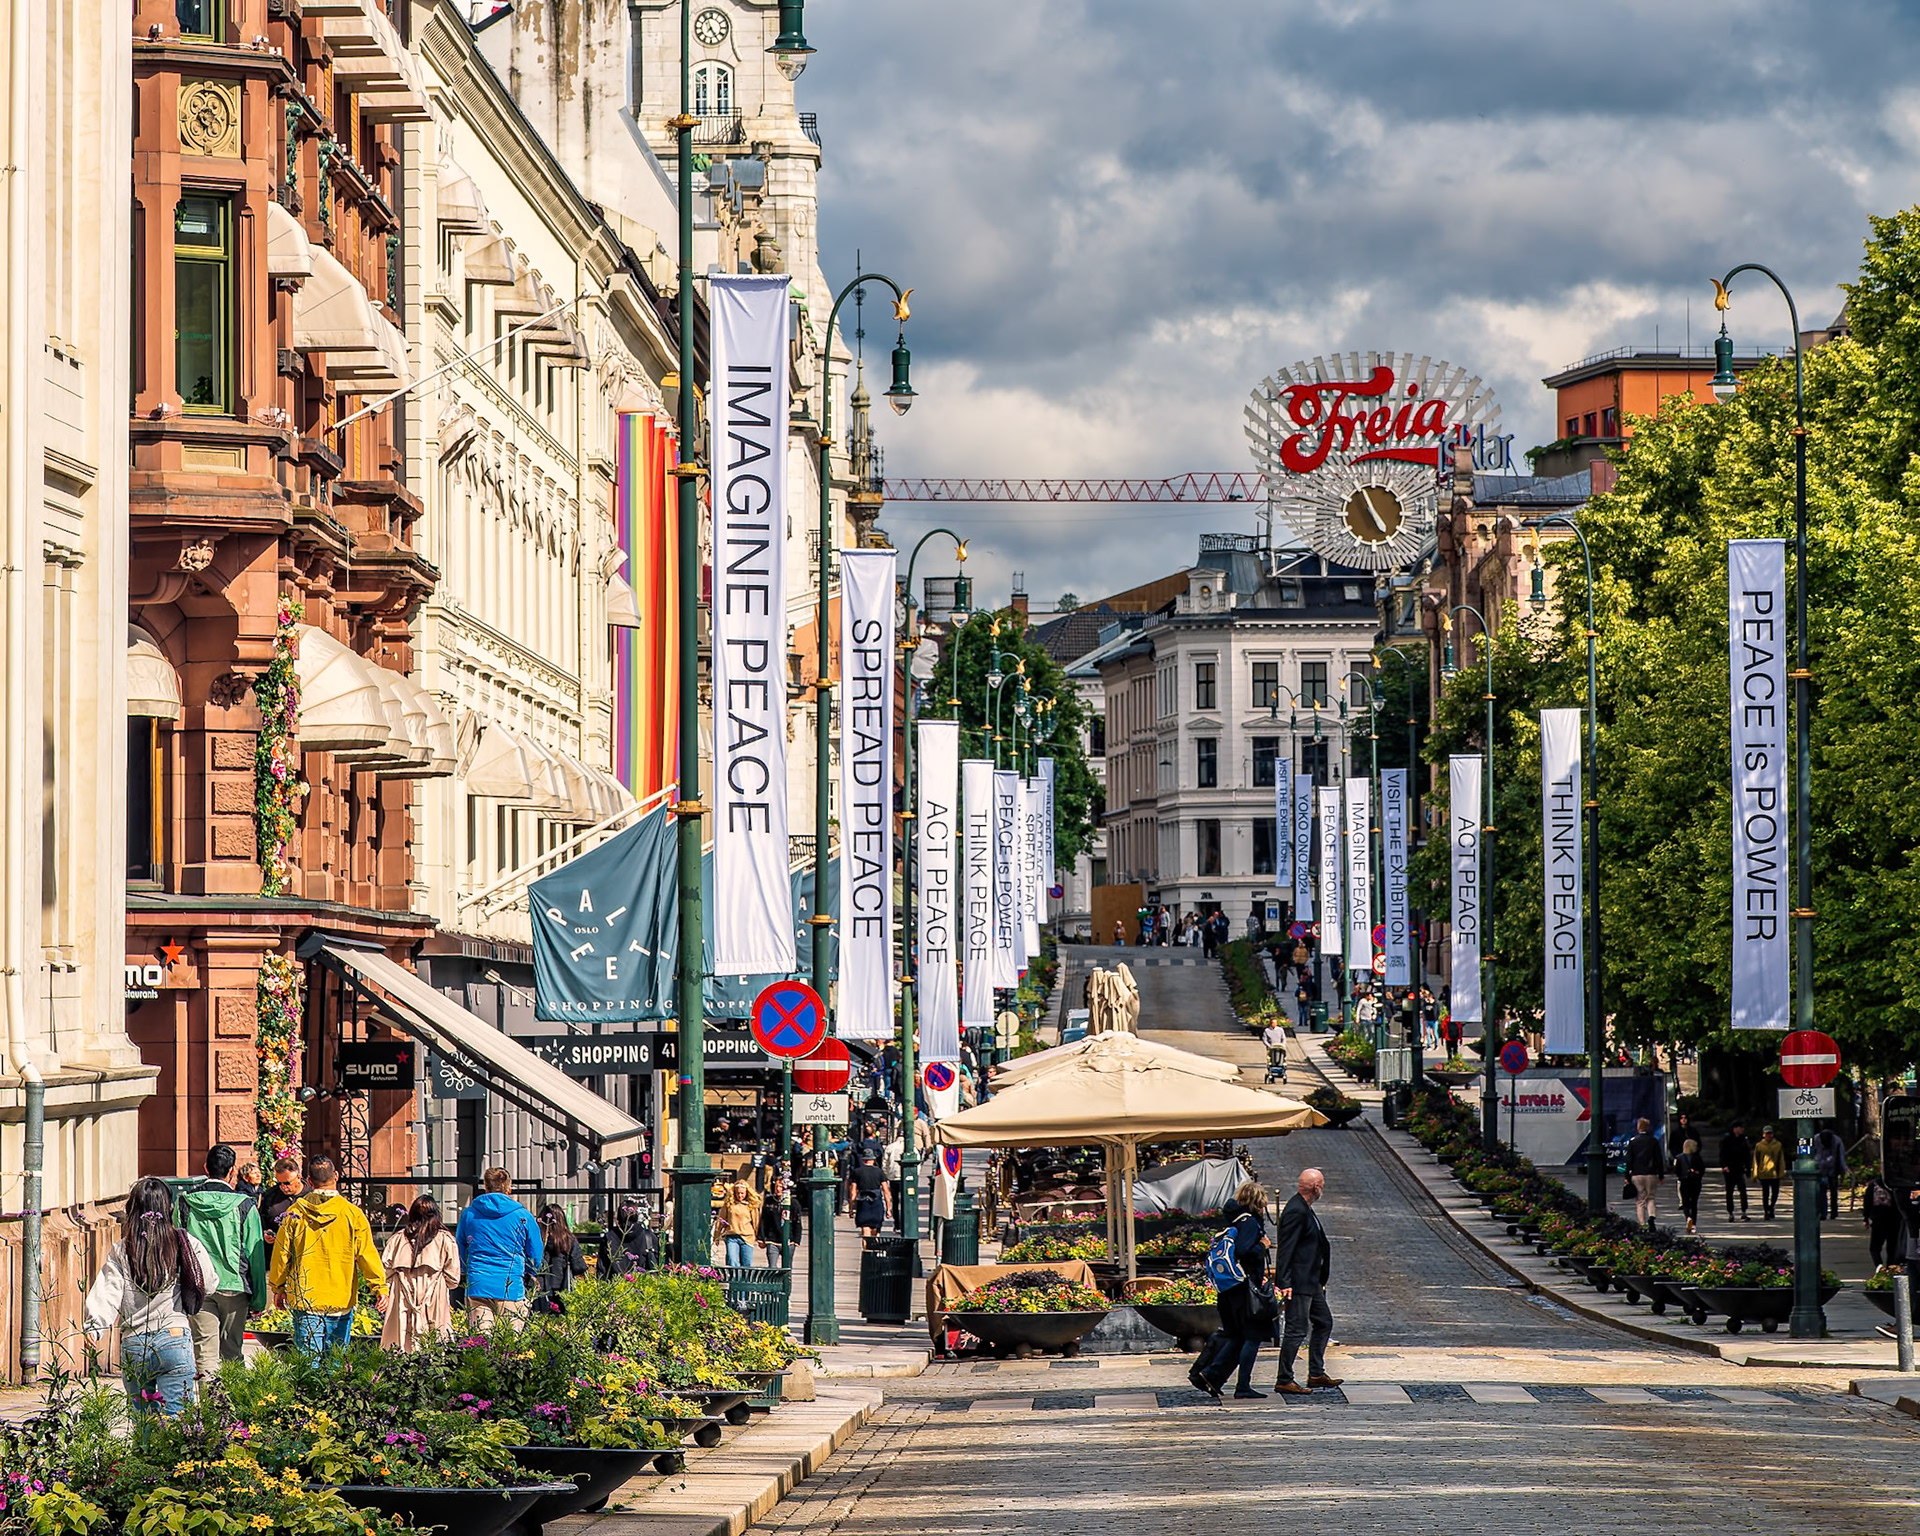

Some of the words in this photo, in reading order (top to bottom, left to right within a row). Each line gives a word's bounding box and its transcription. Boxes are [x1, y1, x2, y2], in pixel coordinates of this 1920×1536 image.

[1277, 366, 1470, 474] Freia
[725, 364, 772, 616] IMAGINE
[1741, 589, 1775, 728] PEACE
[851, 618, 883, 787] SPREAD
[725, 638, 770, 834] PEACE
[1743, 742, 1774, 771] is
[1279, 787, 1288, 806] THE
[1298, 793, 1309, 831] YOKO
[1387, 773, 1401, 814] VISIT
[1550, 774, 1574, 864] THINK
[926, 800, 949, 859] ACT
[969, 809, 988, 878] THINK
[998, 794, 1014, 856] PEACE
[1298, 833, 1309, 863] ONO
[1324, 804, 1336, 853] PEACE
[1351, 802, 1366, 871] IMAGINE
[1389, 819, 1402, 851] THE
[1457, 816, 1476, 862] ACT
[852, 802, 883, 939] PEACE
[997, 861, 1013, 874] is
[1298, 866, 1308, 895] 2024
[1324, 857, 1336, 867] is
[1745, 786, 1777, 942] POWER
[926, 868, 949, 964] PEACE
[969, 886, 988, 961] PEACE
[997, 881, 1013, 950] POWER
[1324, 871, 1337, 925] POWER
[1353, 876, 1367, 931] PEACE
[1389, 854, 1405, 946] EXHIBITION
[1458, 870, 1476, 945] PEACE
[1552, 873, 1576, 970] PEACE
[574, 926, 599, 935] OSLO
[125, 989, 158, 999] staurants
[549, 999, 654, 1011] SHOPPING
[345, 1064, 398, 1075] SUMO
[571, 1045, 649, 1064] SHOPPING
[661, 1042, 676, 1058] 41
[804, 1113, 836, 1122] unntatt
[1791, 1107, 1823, 1116] unntatt
